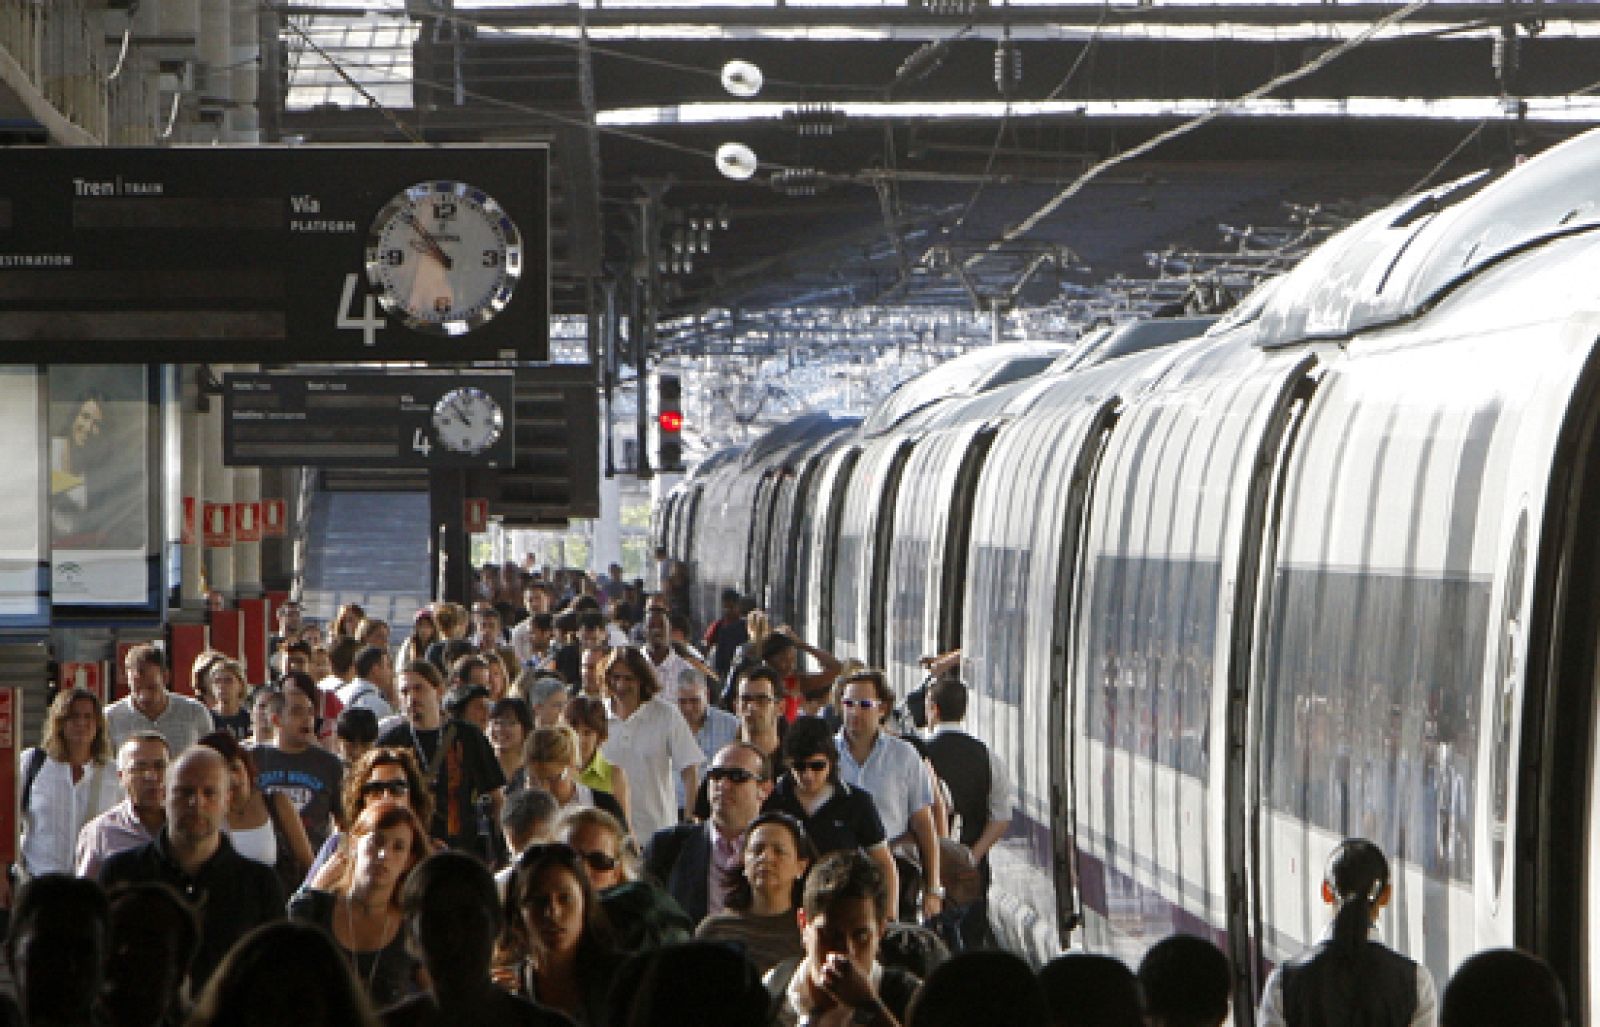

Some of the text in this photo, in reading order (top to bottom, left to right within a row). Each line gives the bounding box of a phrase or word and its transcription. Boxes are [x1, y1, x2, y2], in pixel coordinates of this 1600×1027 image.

[73, 177, 164, 196] Tren TRAIN
[432, 203, 457, 221] 12
[290, 220, 356, 232] PLATFORM
[482, 250, 498, 268] 3
[336, 273, 386, 346] 4
[412, 427, 432, 457] 4
